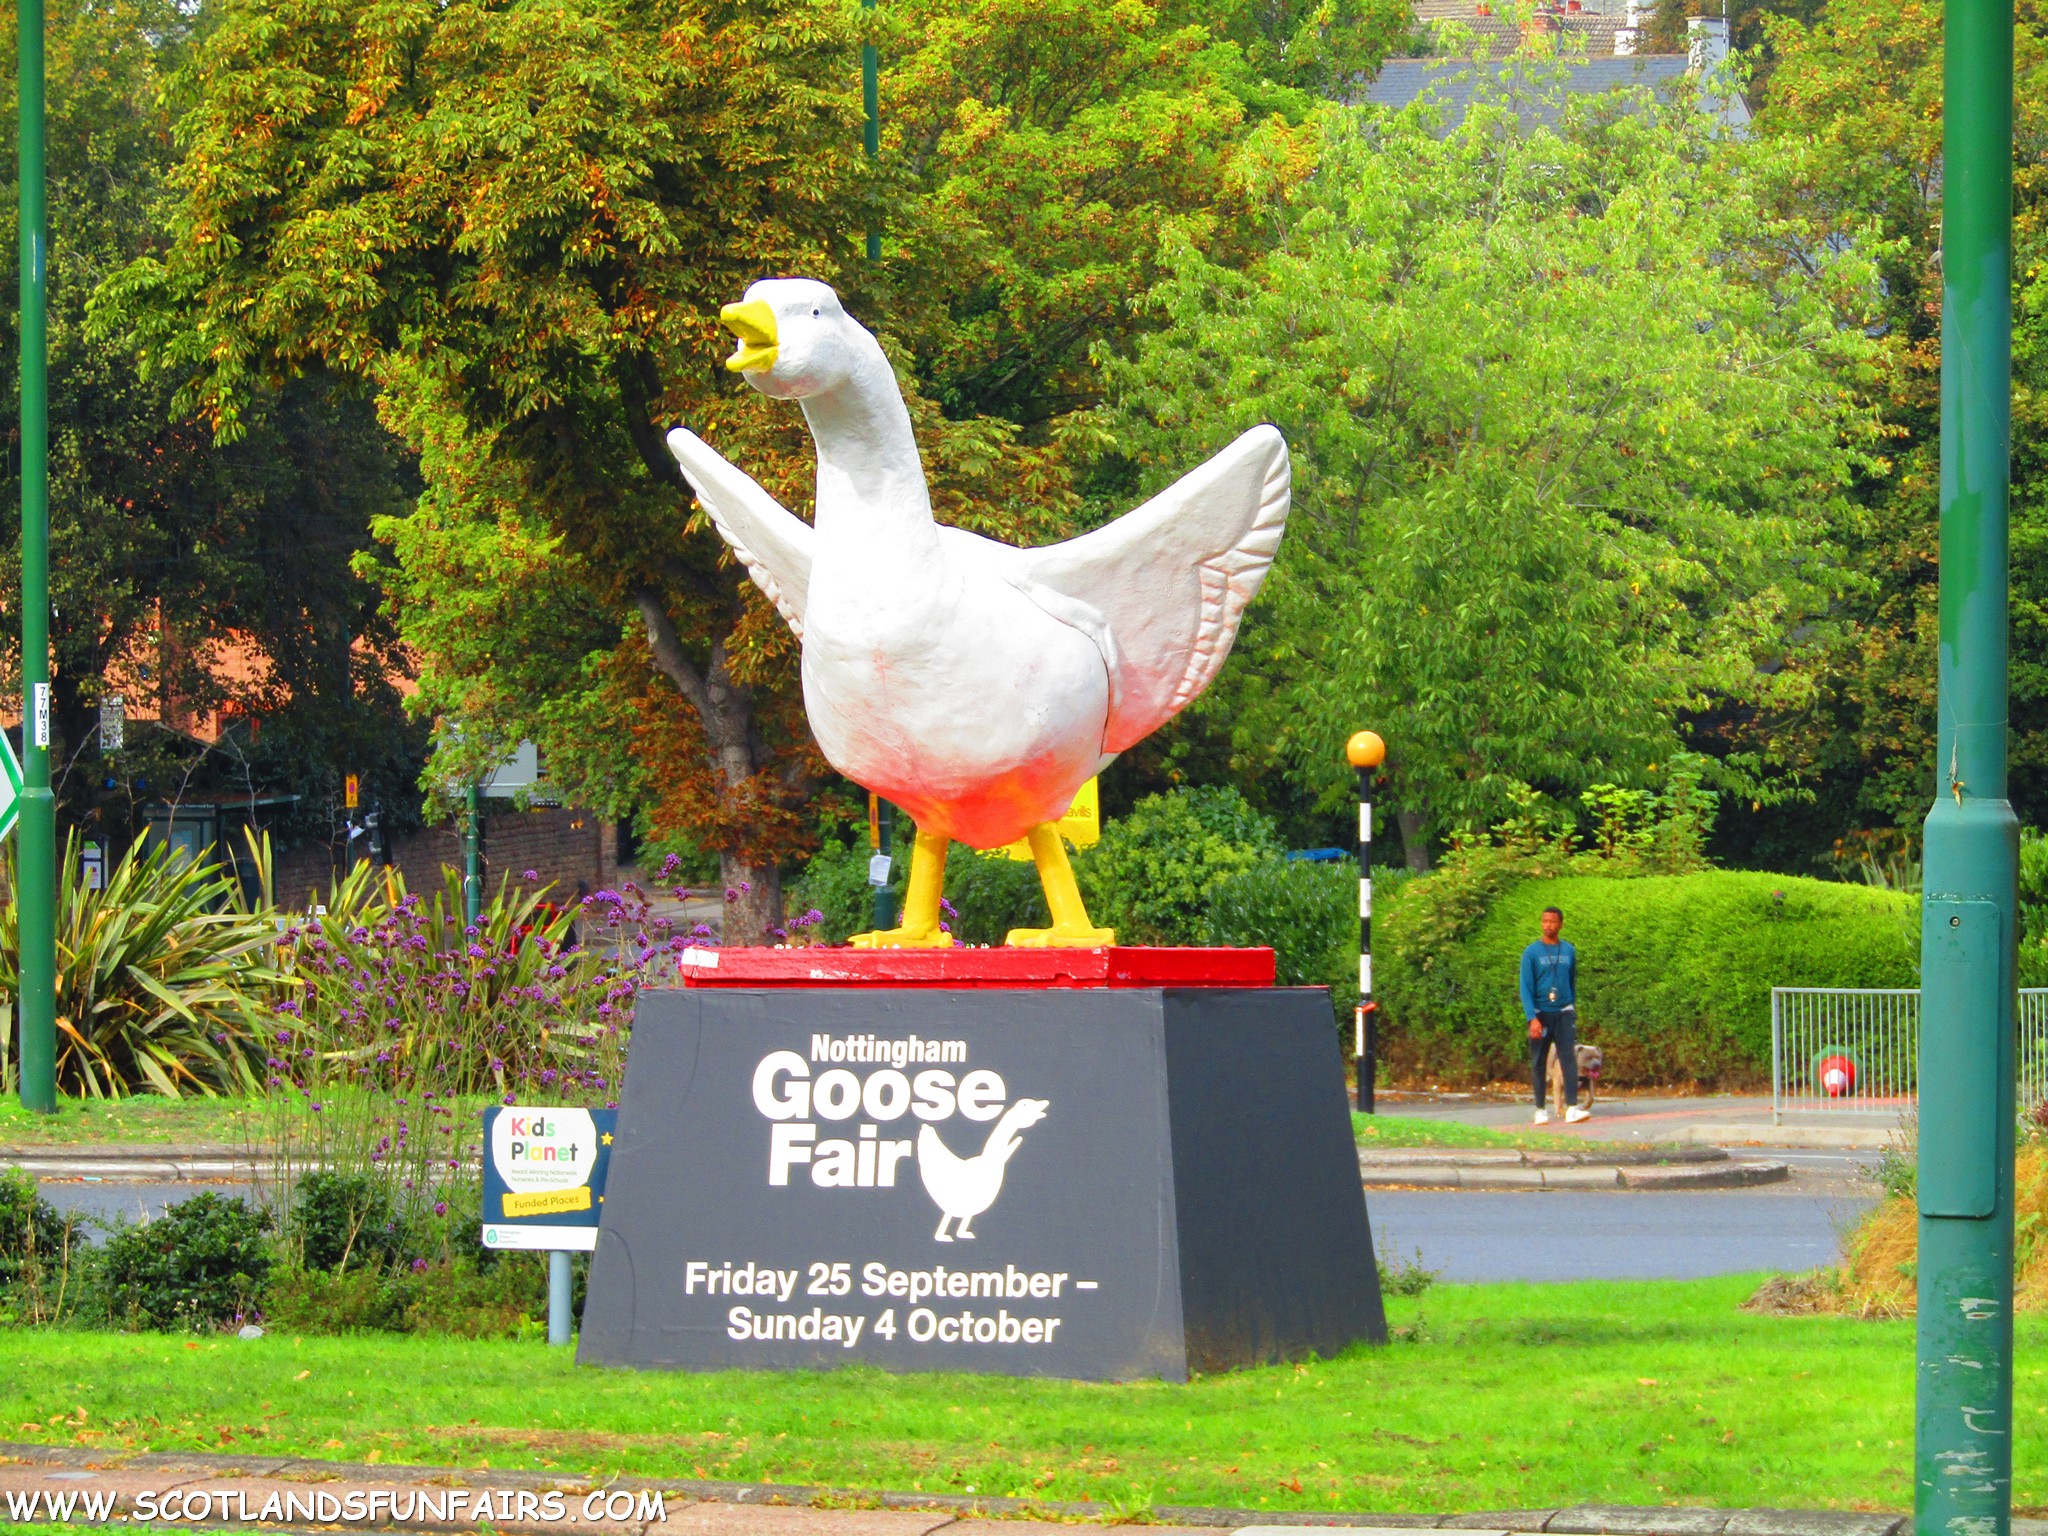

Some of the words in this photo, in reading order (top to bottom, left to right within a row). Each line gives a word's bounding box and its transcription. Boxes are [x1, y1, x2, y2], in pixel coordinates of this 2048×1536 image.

[39, 686, 48, 743] 77M38
[811, 1033, 967, 1069] Nottingham
[752, 1050, 1007, 1121] Goose
[511, 1117, 556, 1137] Kids
[511, 1141, 578, 1161] Planet
[768, 1123, 912, 1187] Fair
[514, 1196, 548, 1209] Funded
[550, 1195, 580, 1205] Places
[685, 1262, 799, 1302] Friday
[807, 1263, 851, 1295] 25
[861, 1263, 1068, 1303] September
[727, 1306, 865, 1347] Sunday
[874, 1308, 897, 1341] 4
[907, 1308, 1061, 1344] October
